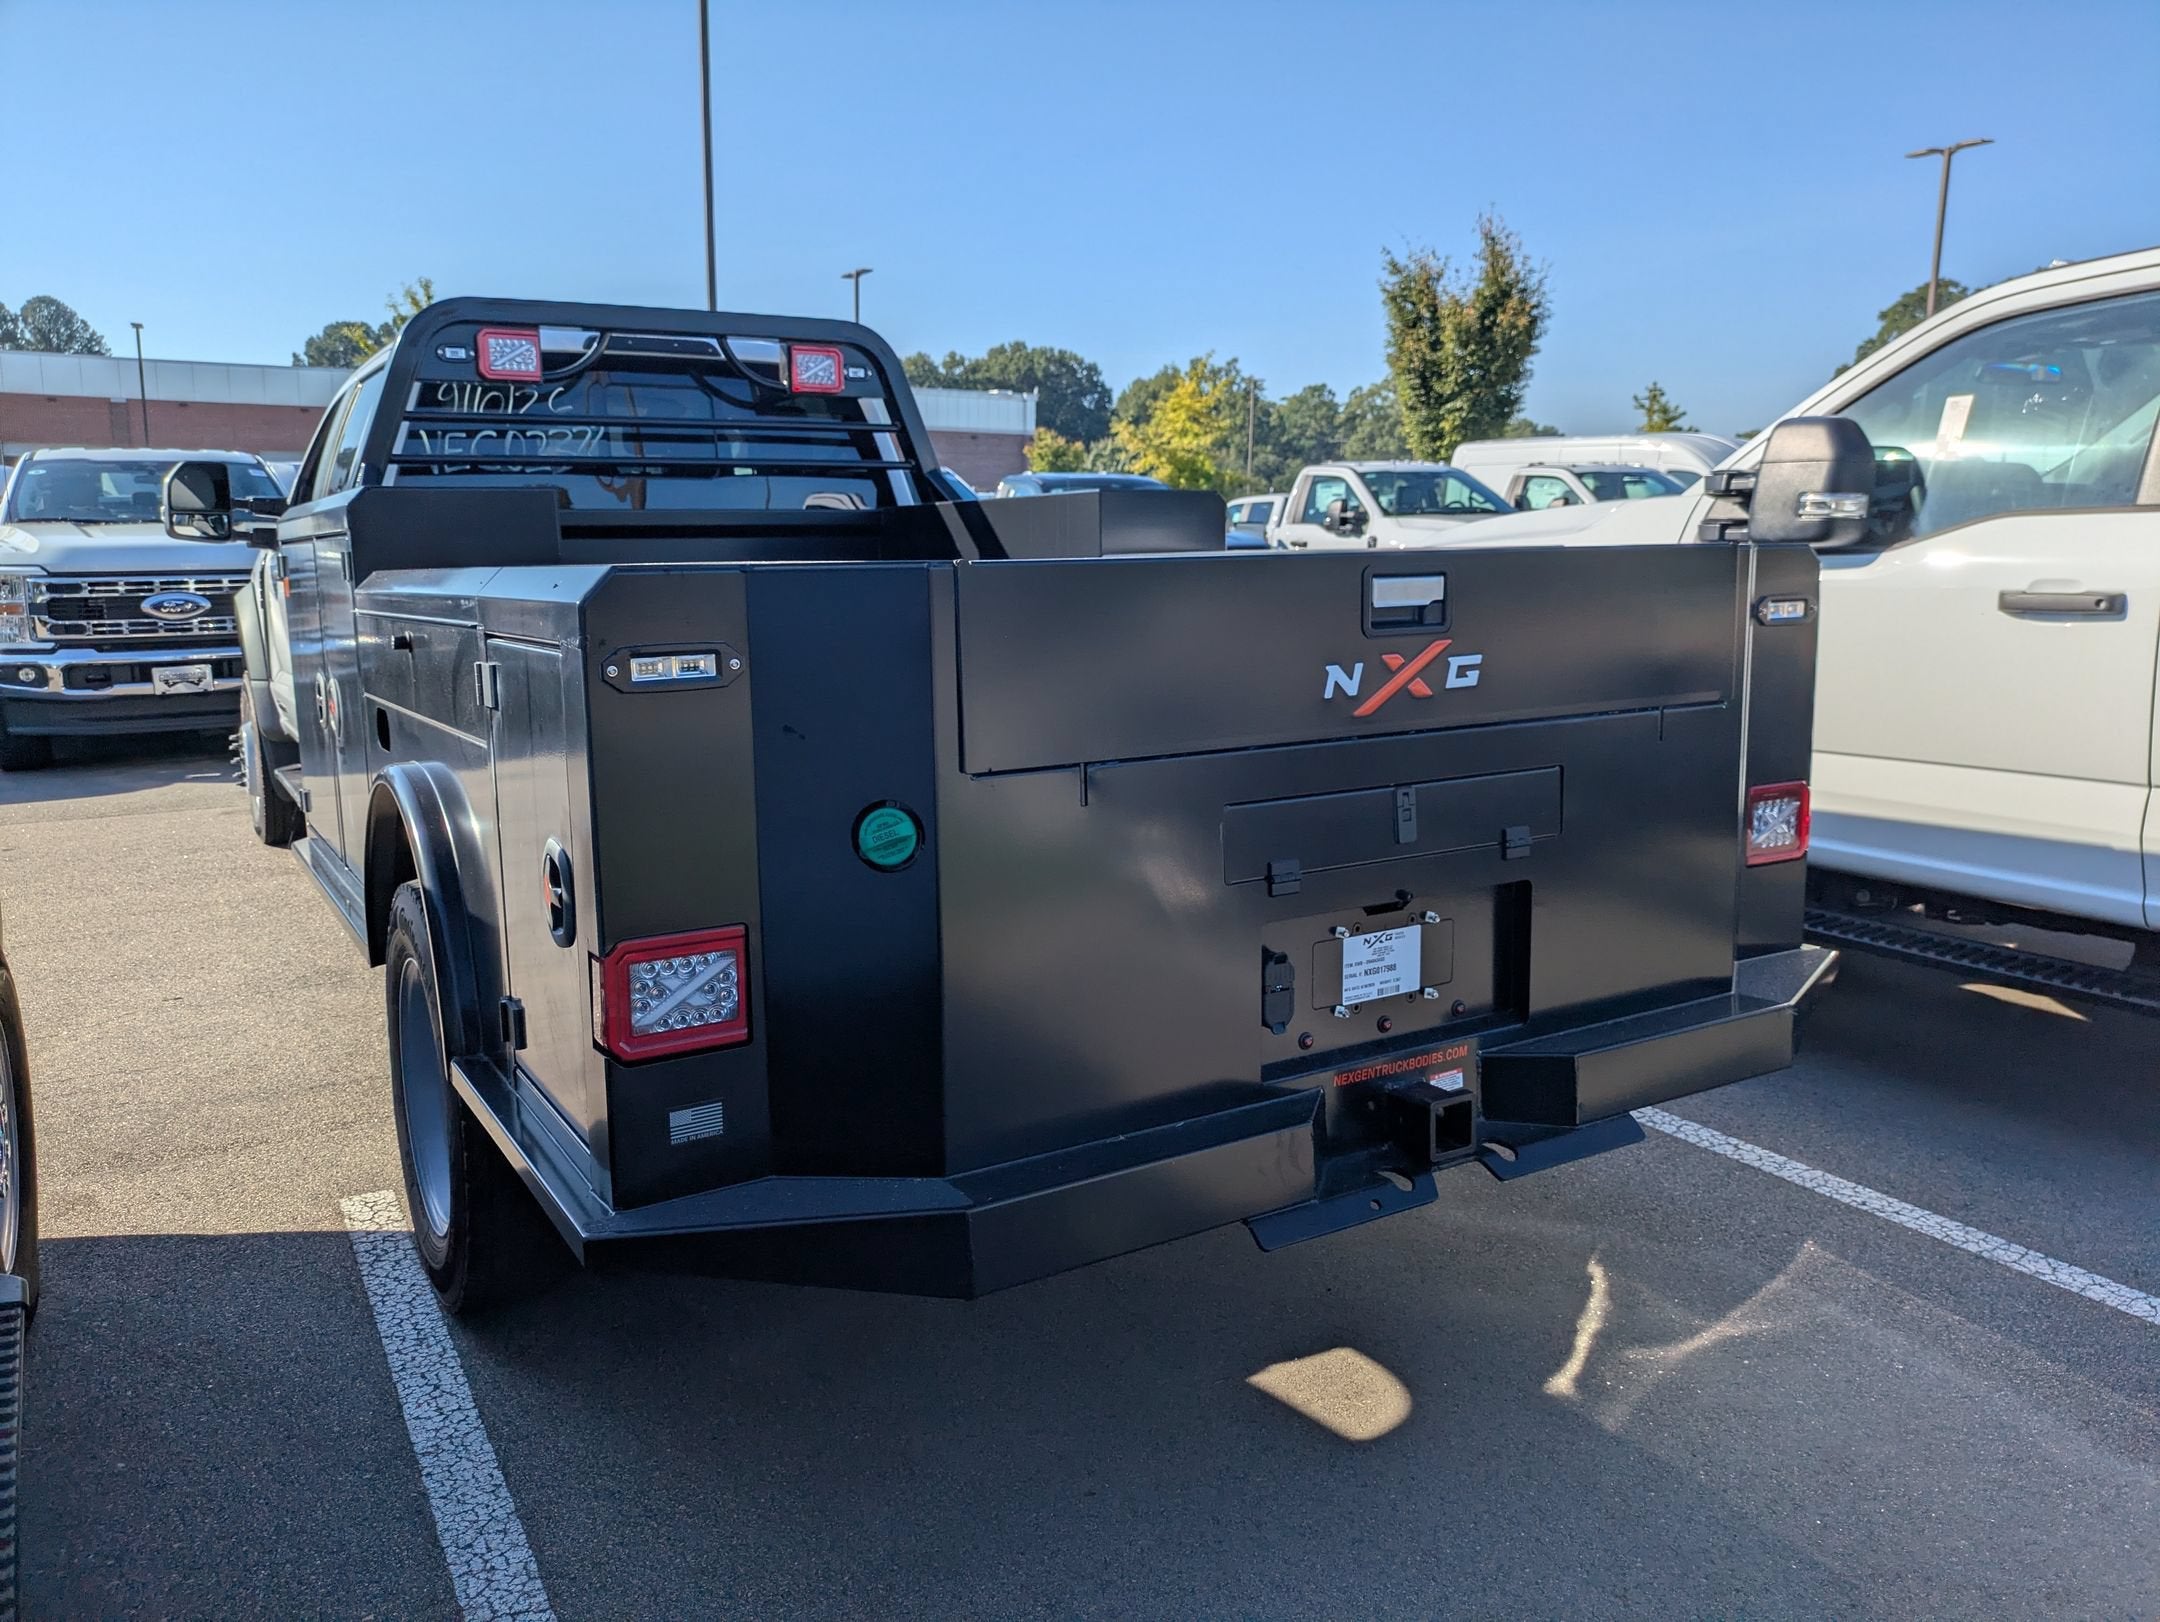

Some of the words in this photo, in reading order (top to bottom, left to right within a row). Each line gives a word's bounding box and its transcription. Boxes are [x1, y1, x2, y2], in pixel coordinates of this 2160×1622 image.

[1323, 639, 1483, 717] NXG
[1363, 932, 1393, 949] NXG
[1332, 1045, 1468, 1088] NEXGENTRUCKBODIES.COM
[671, 1136, 688, 1145] MADE
[697, 1129, 723, 1139] AMERICA
